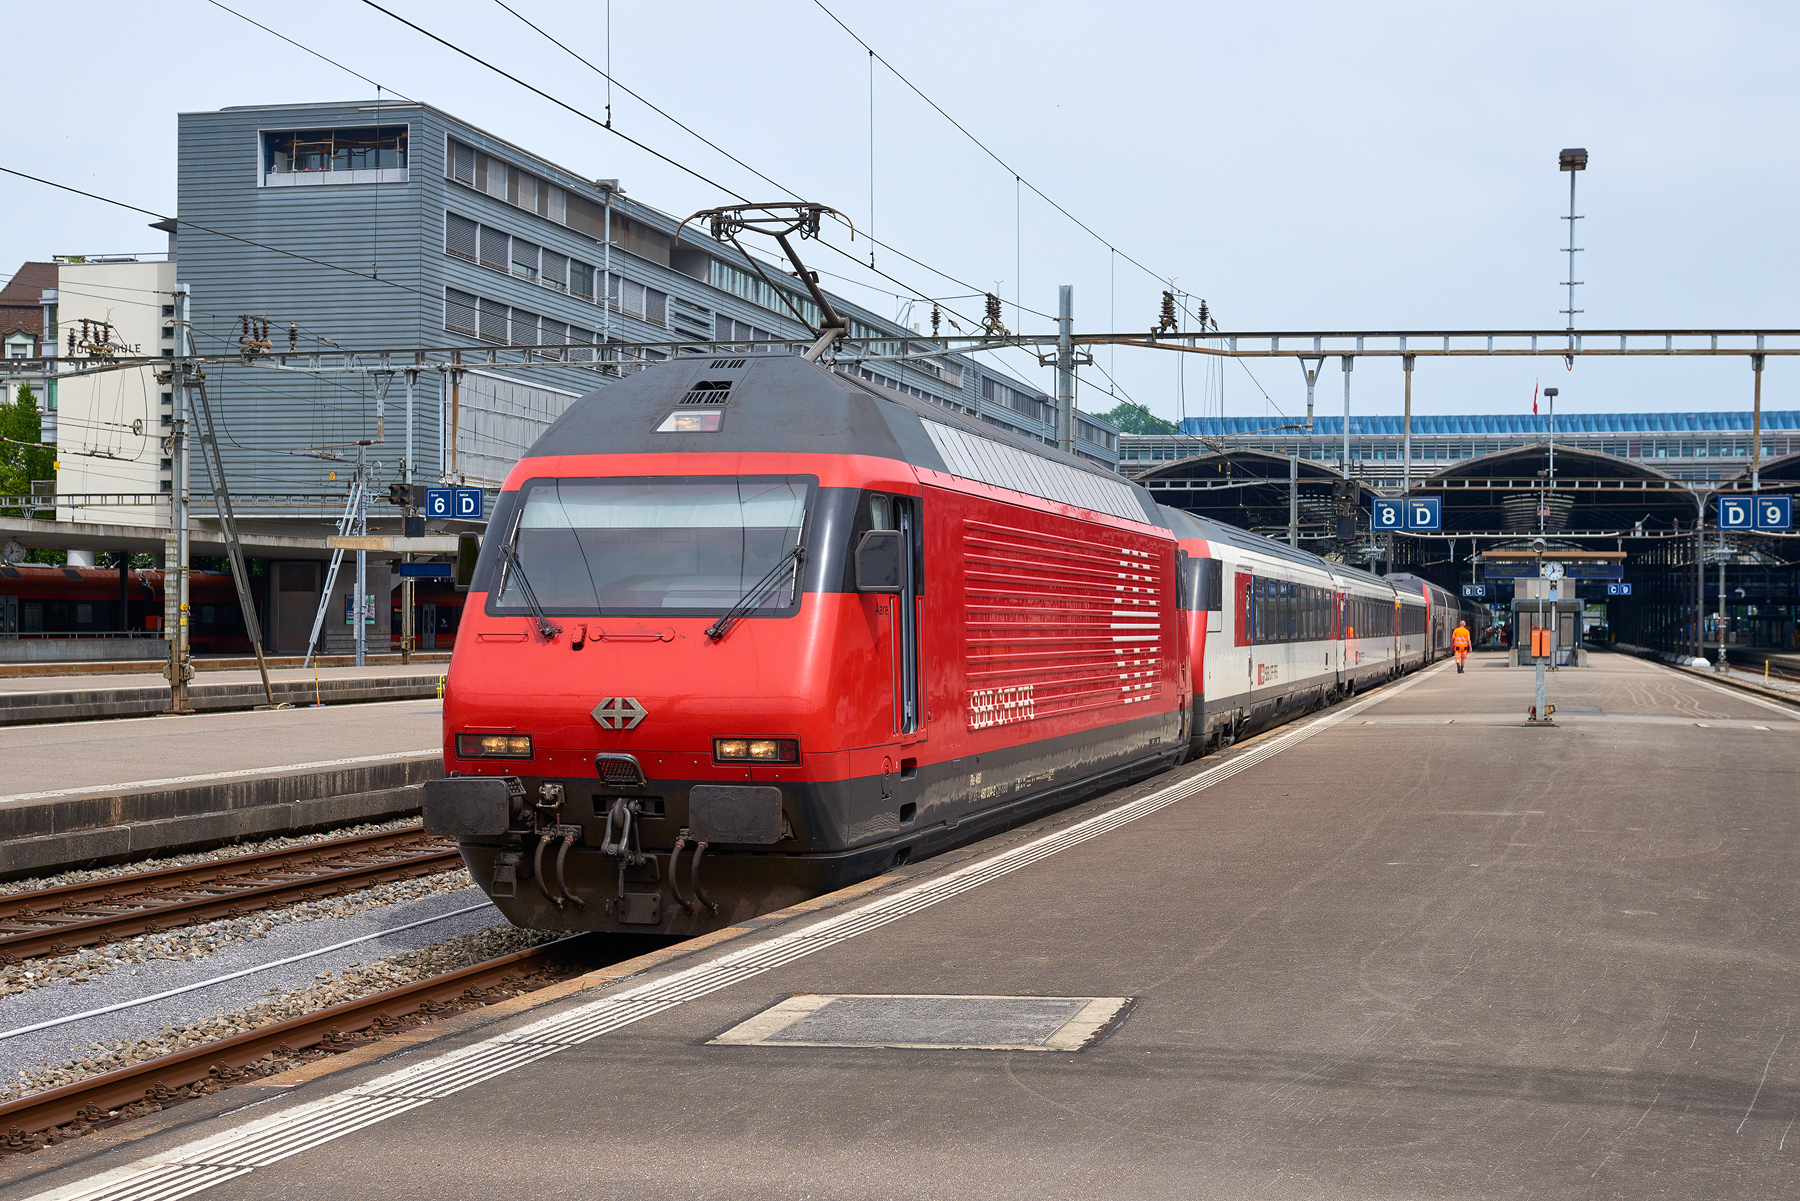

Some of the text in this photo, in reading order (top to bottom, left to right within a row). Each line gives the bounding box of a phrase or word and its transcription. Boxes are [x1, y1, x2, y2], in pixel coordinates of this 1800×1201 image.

[434, 497, 445, 513] 6
[462, 497, 474, 513] D
[1382, 507, 1395, 525] 8
[1416, 507, 1431, 525] D
[1728, 506, 1745, 524] D
[1766, 506, 1781, 524] 9
[875, 602, 888, 615] Aare
[970, 690, 994, 729] SBB
[1016, 684, 1035, 721] FFS
